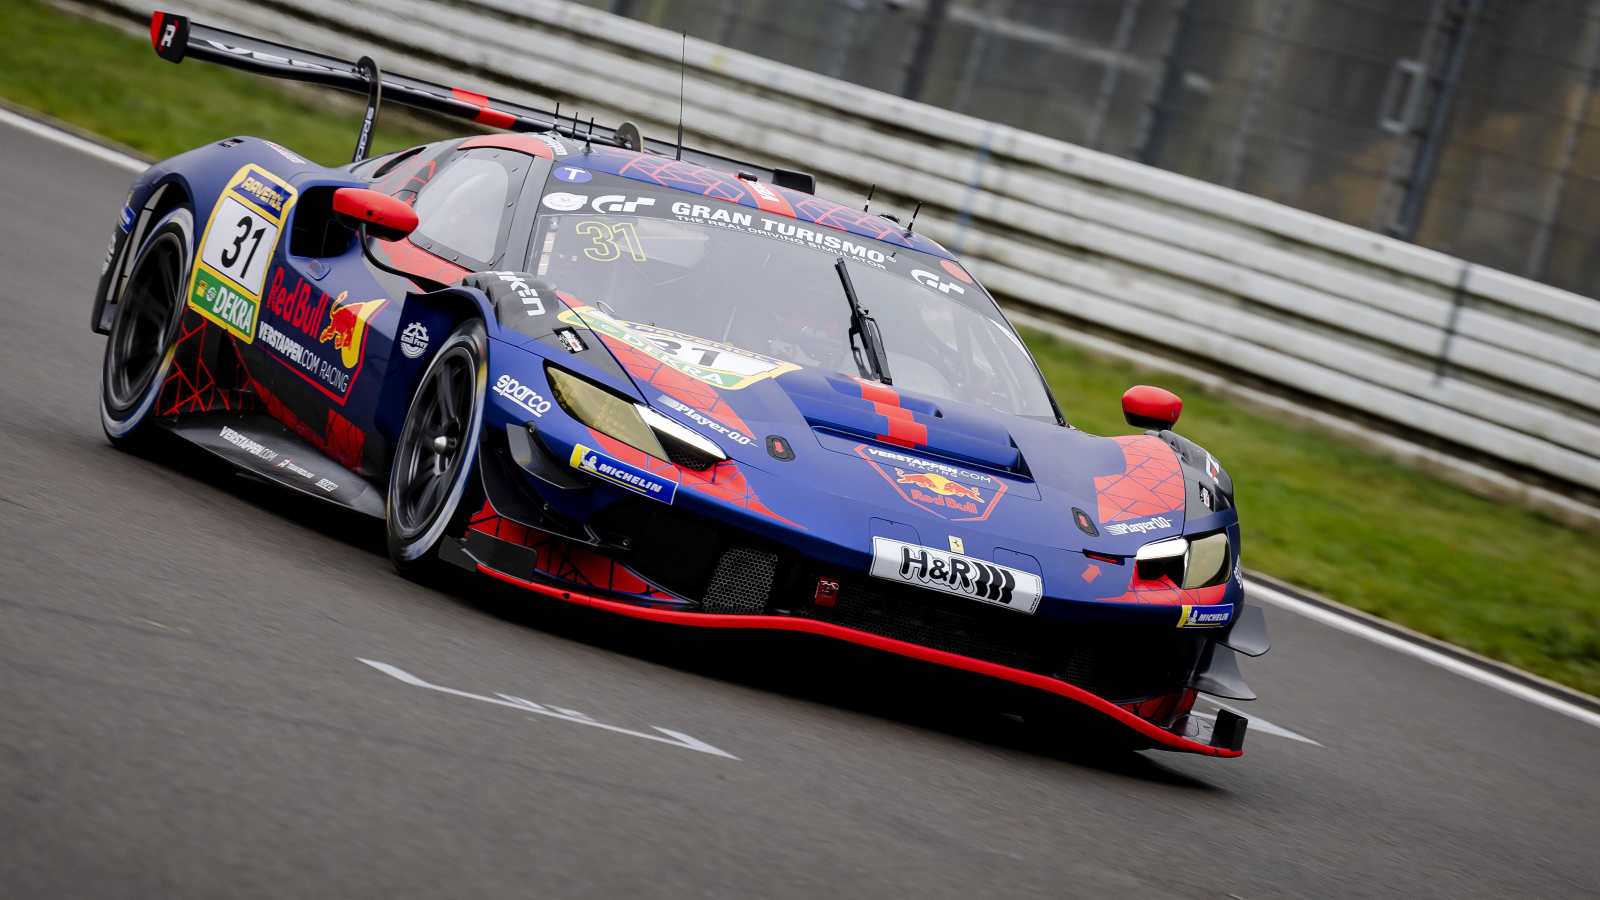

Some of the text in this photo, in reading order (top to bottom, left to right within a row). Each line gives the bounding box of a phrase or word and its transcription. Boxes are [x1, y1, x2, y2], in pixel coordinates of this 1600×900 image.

[221, 215, 267, 280] 31
[575, 221, 647, 262] 31
[671, 201, 885, 263] GRAN TURISMO
[213, 286, 255, 334] DEKRA
[266, 266, 330, 339] Red Bull
[258, 321, 350, 393] VERSTAPPEN.COM RACING
[493, 374, 552, 418] sparco
[676, 403, 731, 435] Player
[598, 463, 664, 493] MICHELIN
[867, 447, 992, 485] VERSTAPPEN.COM
[908, 462, 959, 479] RACING
[1117, 518, 1156, 534] Player
[901, 546, 974, 592] H&R
[1197, 612, 1230, 623] MICHELIN
